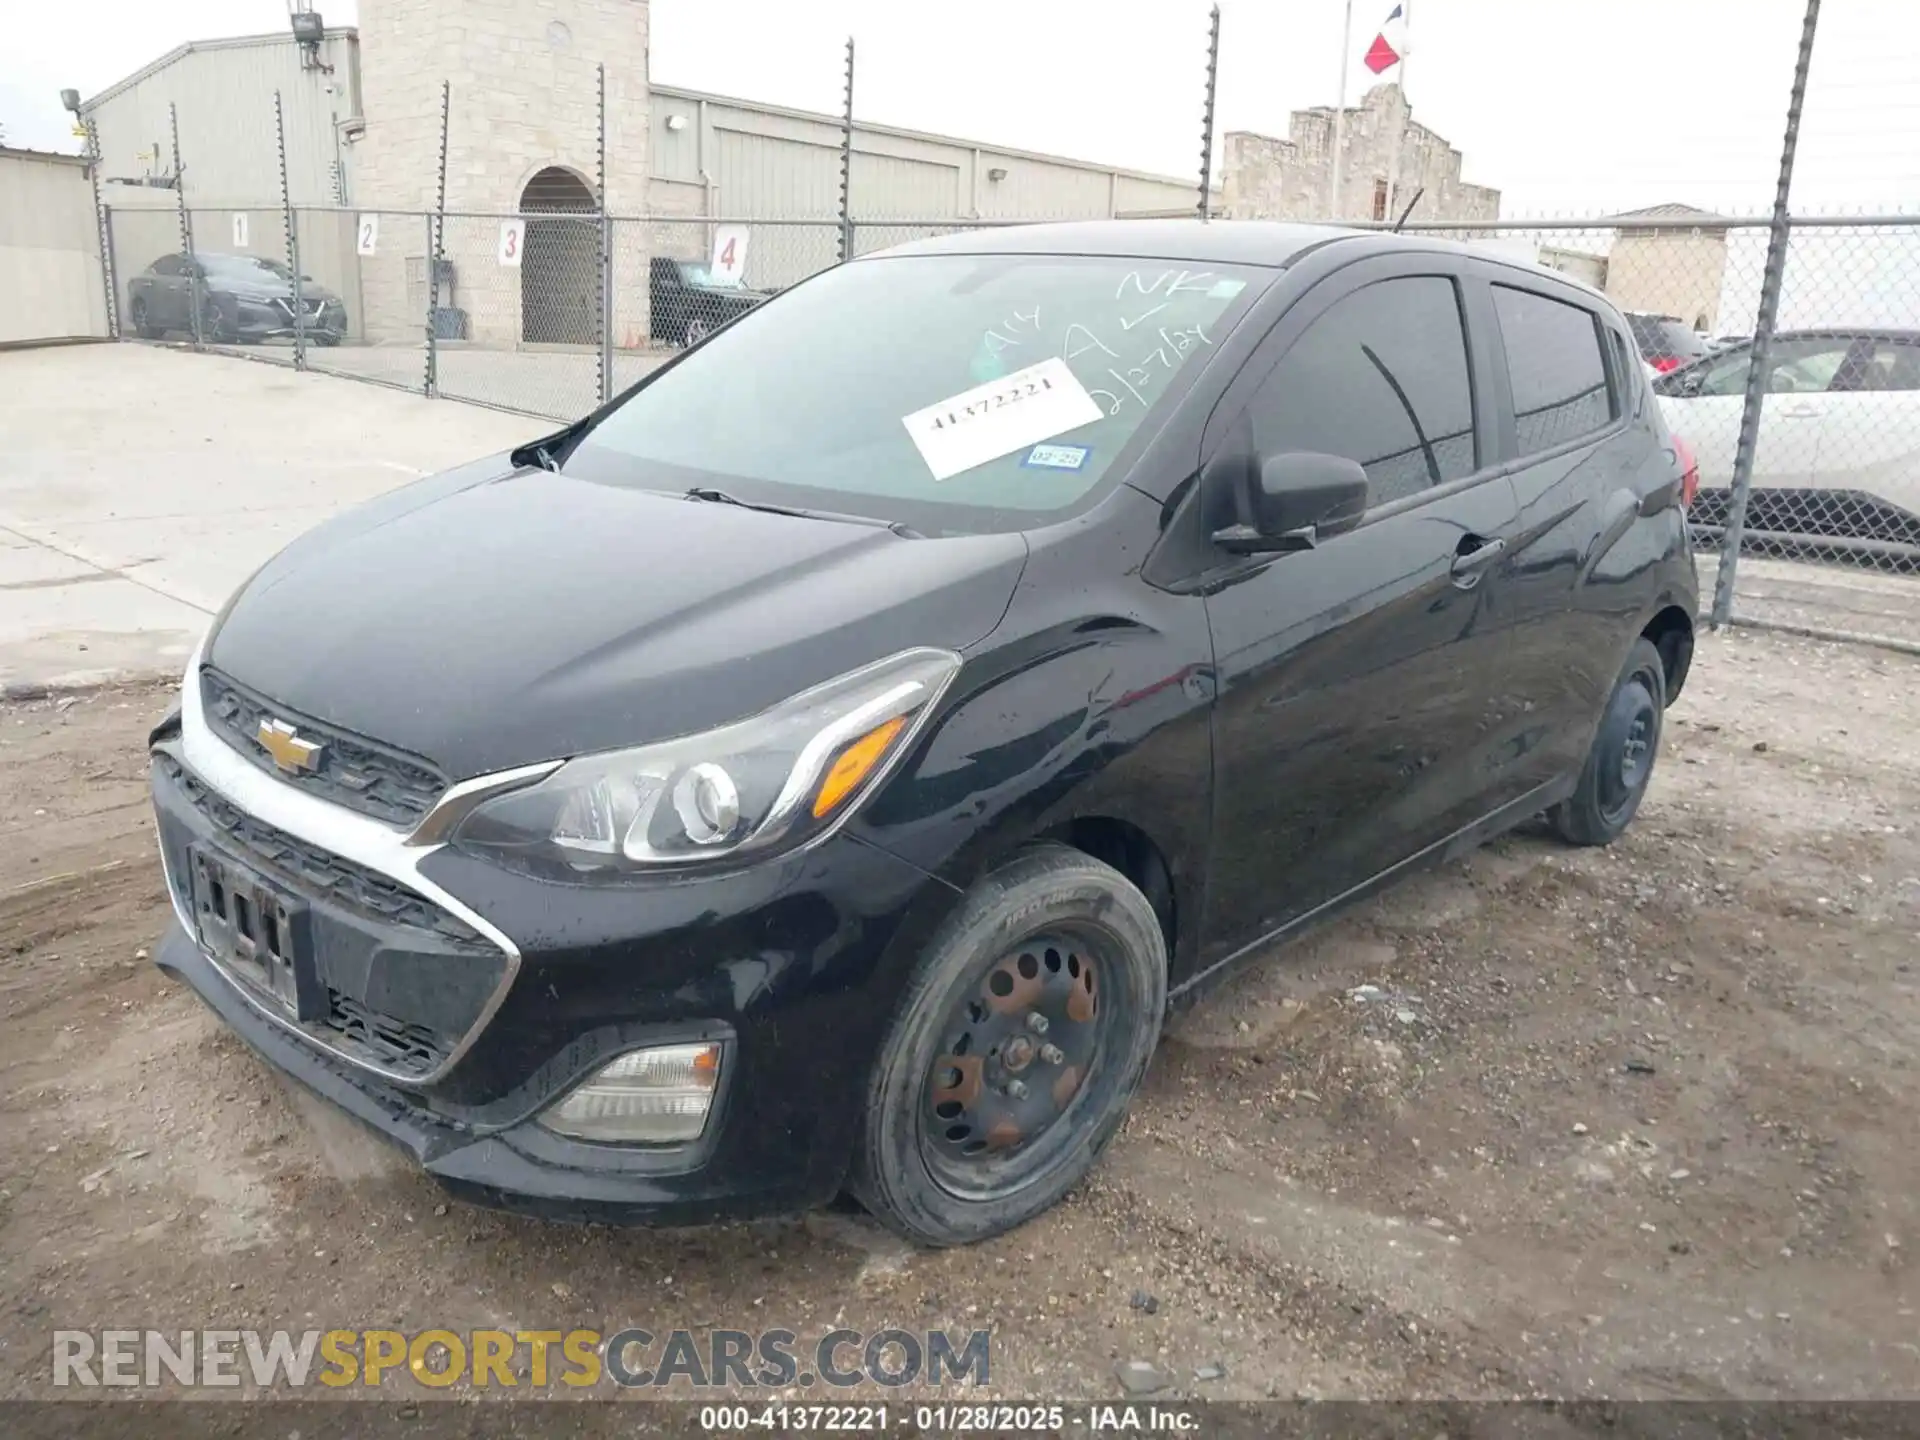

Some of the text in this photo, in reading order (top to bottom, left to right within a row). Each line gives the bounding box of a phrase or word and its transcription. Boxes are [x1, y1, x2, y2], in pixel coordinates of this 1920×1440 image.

[235, 216, 244, 242] 1
[361, 223, 374, 249] 2
[504, 229, 518, 258] 3
[720, 236, 737, 272] 4
[1116, 269, 1213, 299] NK
[930, 377, 1053, 430] 41372221
